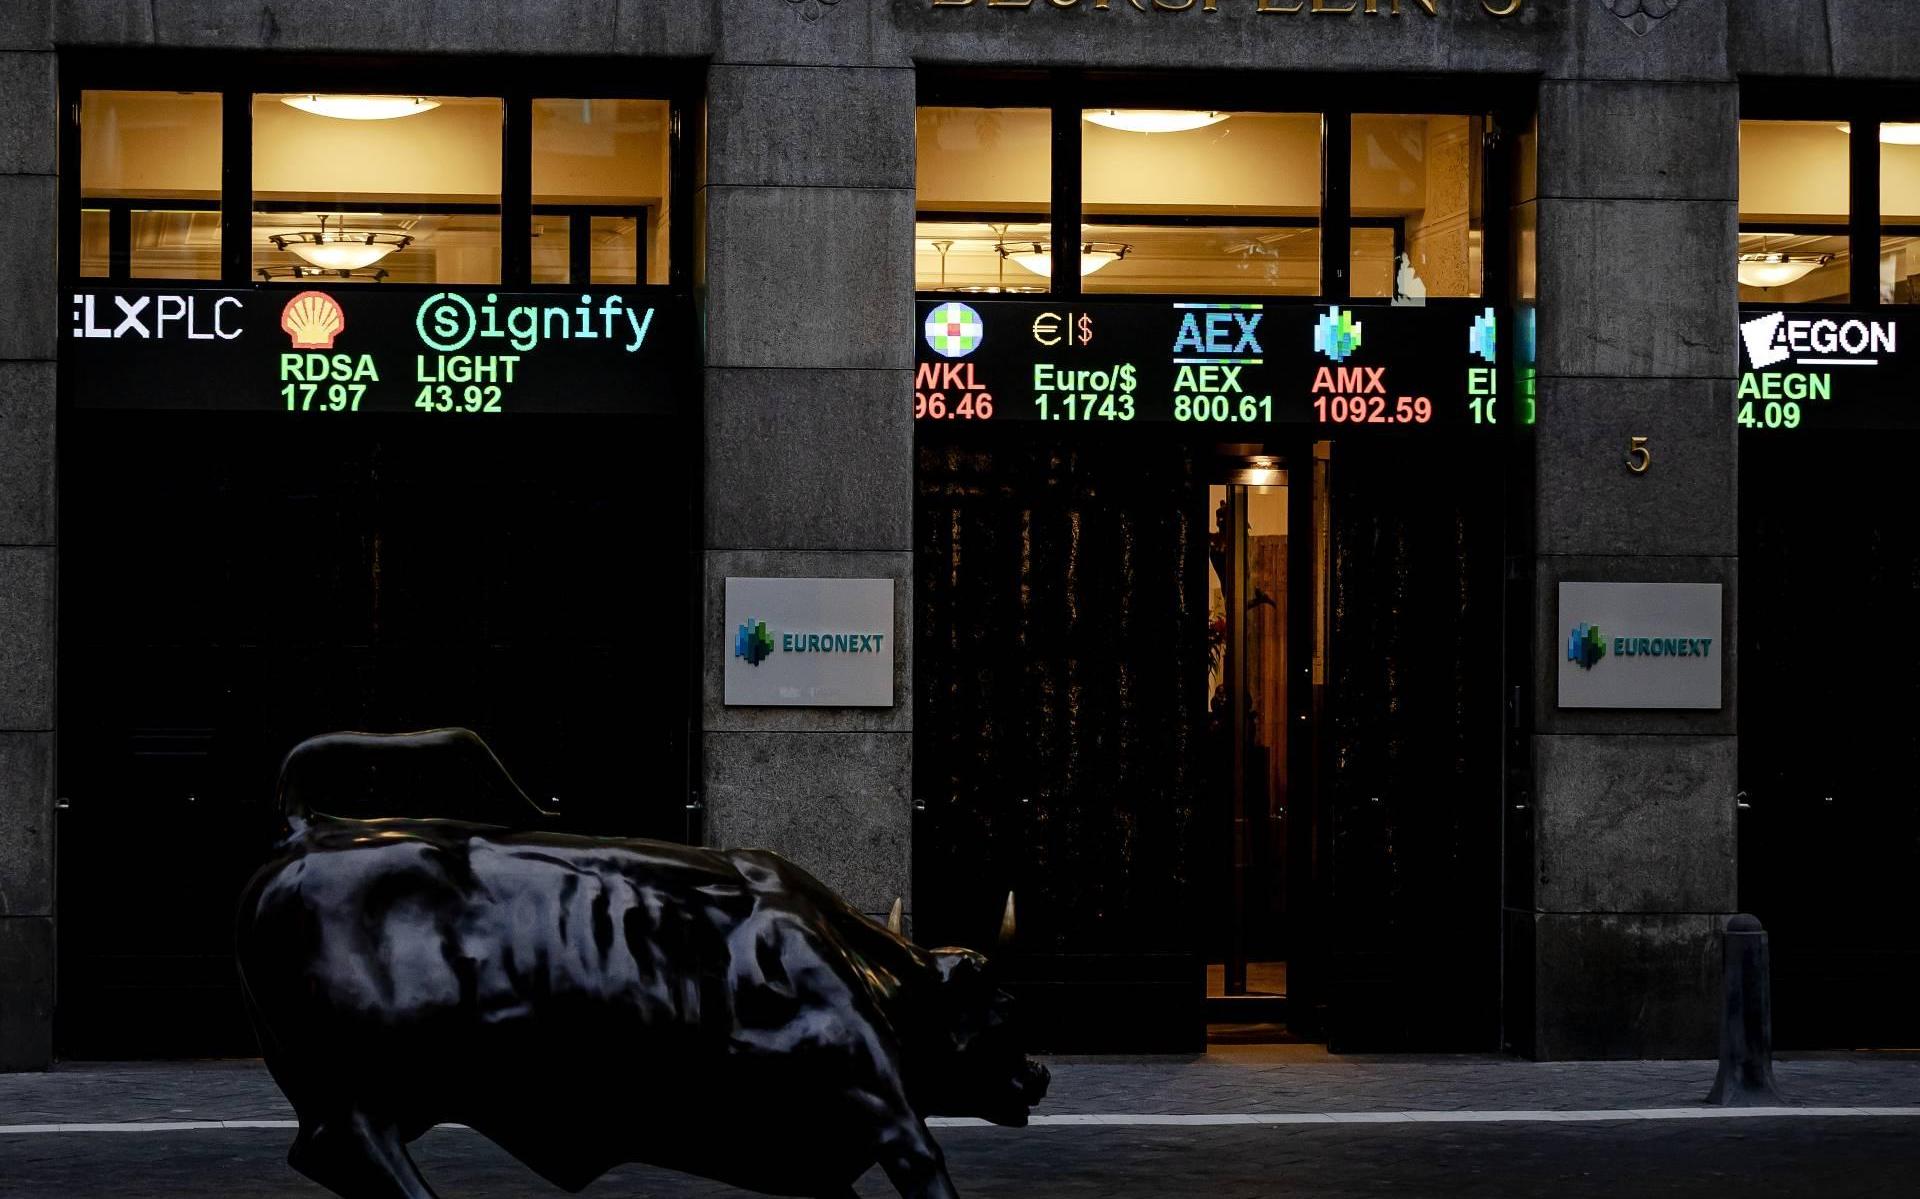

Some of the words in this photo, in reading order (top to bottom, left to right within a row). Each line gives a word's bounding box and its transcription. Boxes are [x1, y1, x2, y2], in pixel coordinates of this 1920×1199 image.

[157, 295, 244, 340] PLC
[415, 292, 656, 353] Signify
[1173, 313, 1264, 353] AEX
[1764, 316, 1897, 354] AEGON
[280, 353, 380, 382] RDSA
[417, 354, 521, 383] LIGHT
[915, 362, 986, 390] WKL
[1034, 362, 1137, 392] Euro/$
[1173, 366, 1243, 392] AEX
[1311, 366, 1386, 394] AMX
[281, 383, 367, 412] 17.97
[414, 384, 503, 413] 43.92
[1737, 372, 1831, 400] AEGN
[1035, 391, 1136, 421] 1.1743
[1174, 394, 1275, 422] 800.61
[1313, 395, 1432, 424] 1092.59
[1737, 401, 1801, 429] 4.09
[1625, 436, 1651, 474] 5
[783, 633, 884, 653] EURONEXT
[1613, 637, 1713, 657] EURONEXT
